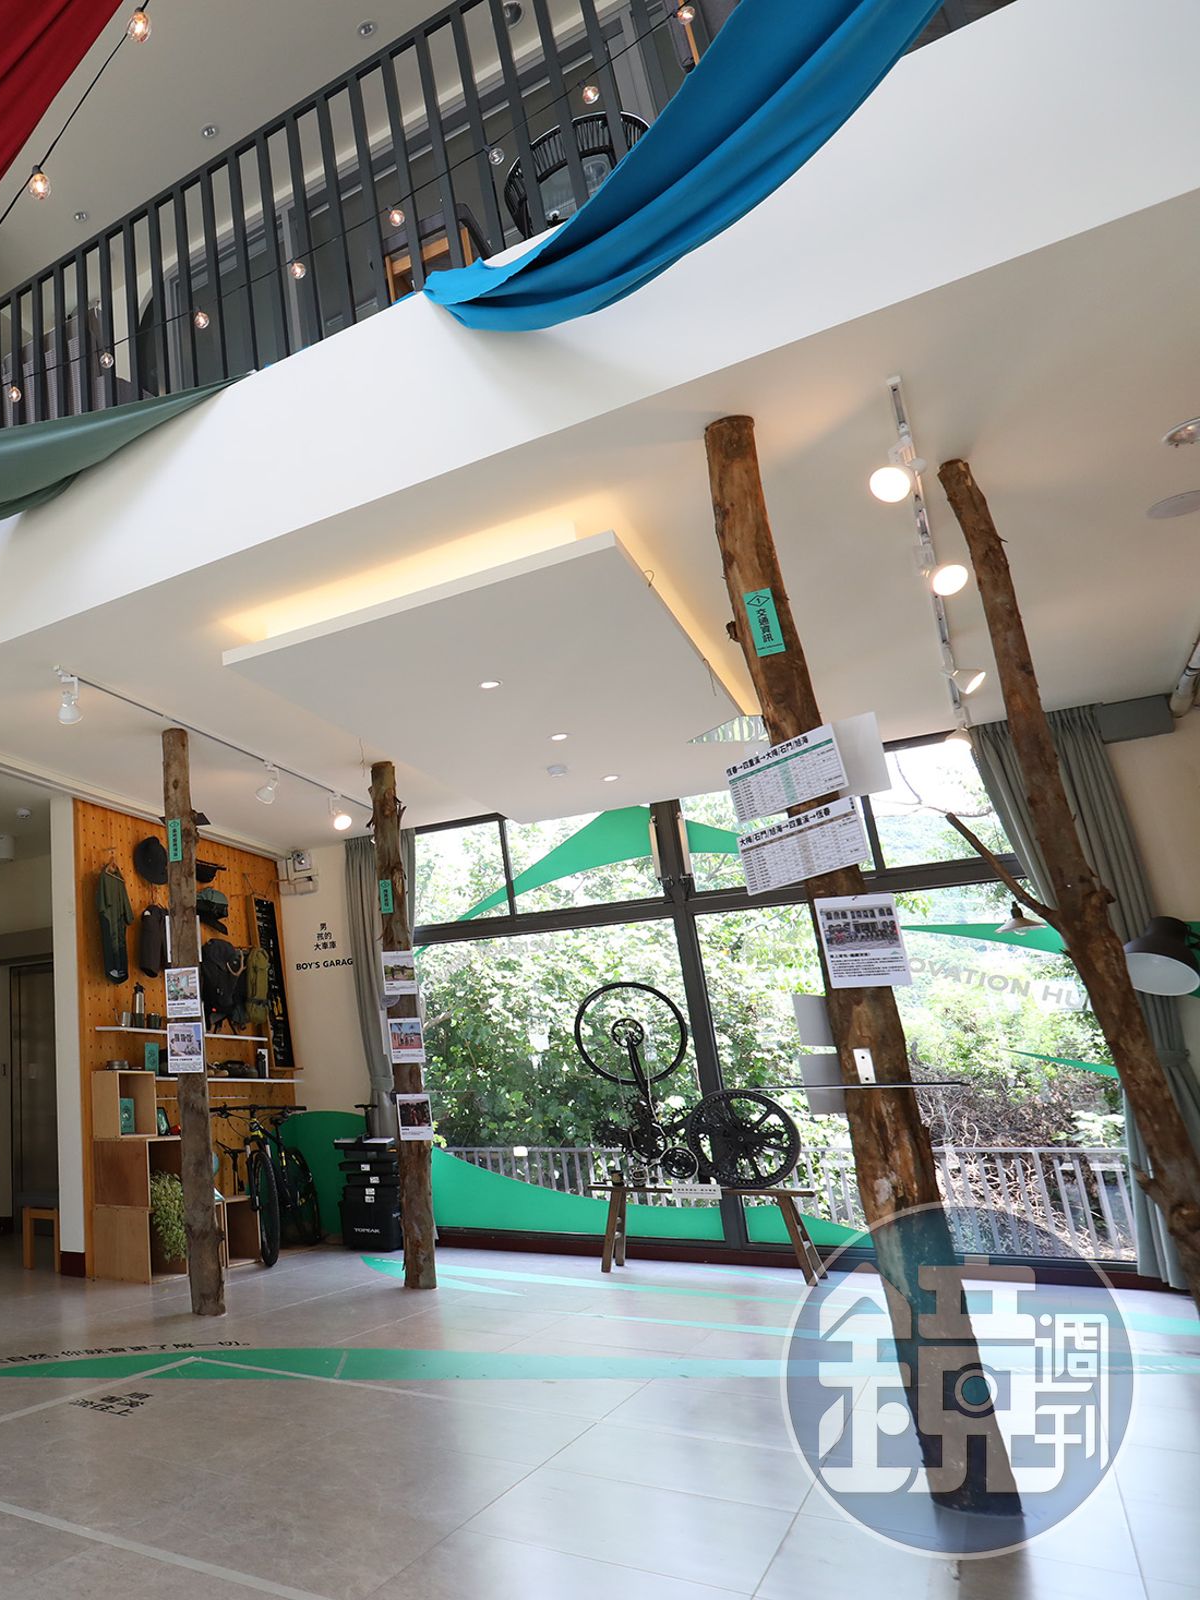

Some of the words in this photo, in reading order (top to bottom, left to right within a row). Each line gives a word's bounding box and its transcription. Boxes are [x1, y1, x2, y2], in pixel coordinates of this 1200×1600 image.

[755, 608, 774, 643] 交通資訊
[319, 922, 327, 931] 男
[313, 941, 336, 951] 大車庫
[296, 961, 320, 971] BOY'S
[322, 958, 353, 968] GARAG
[908, 957, 1031, 996] OVATION
[1041, 985, 1090, 1009] HU
